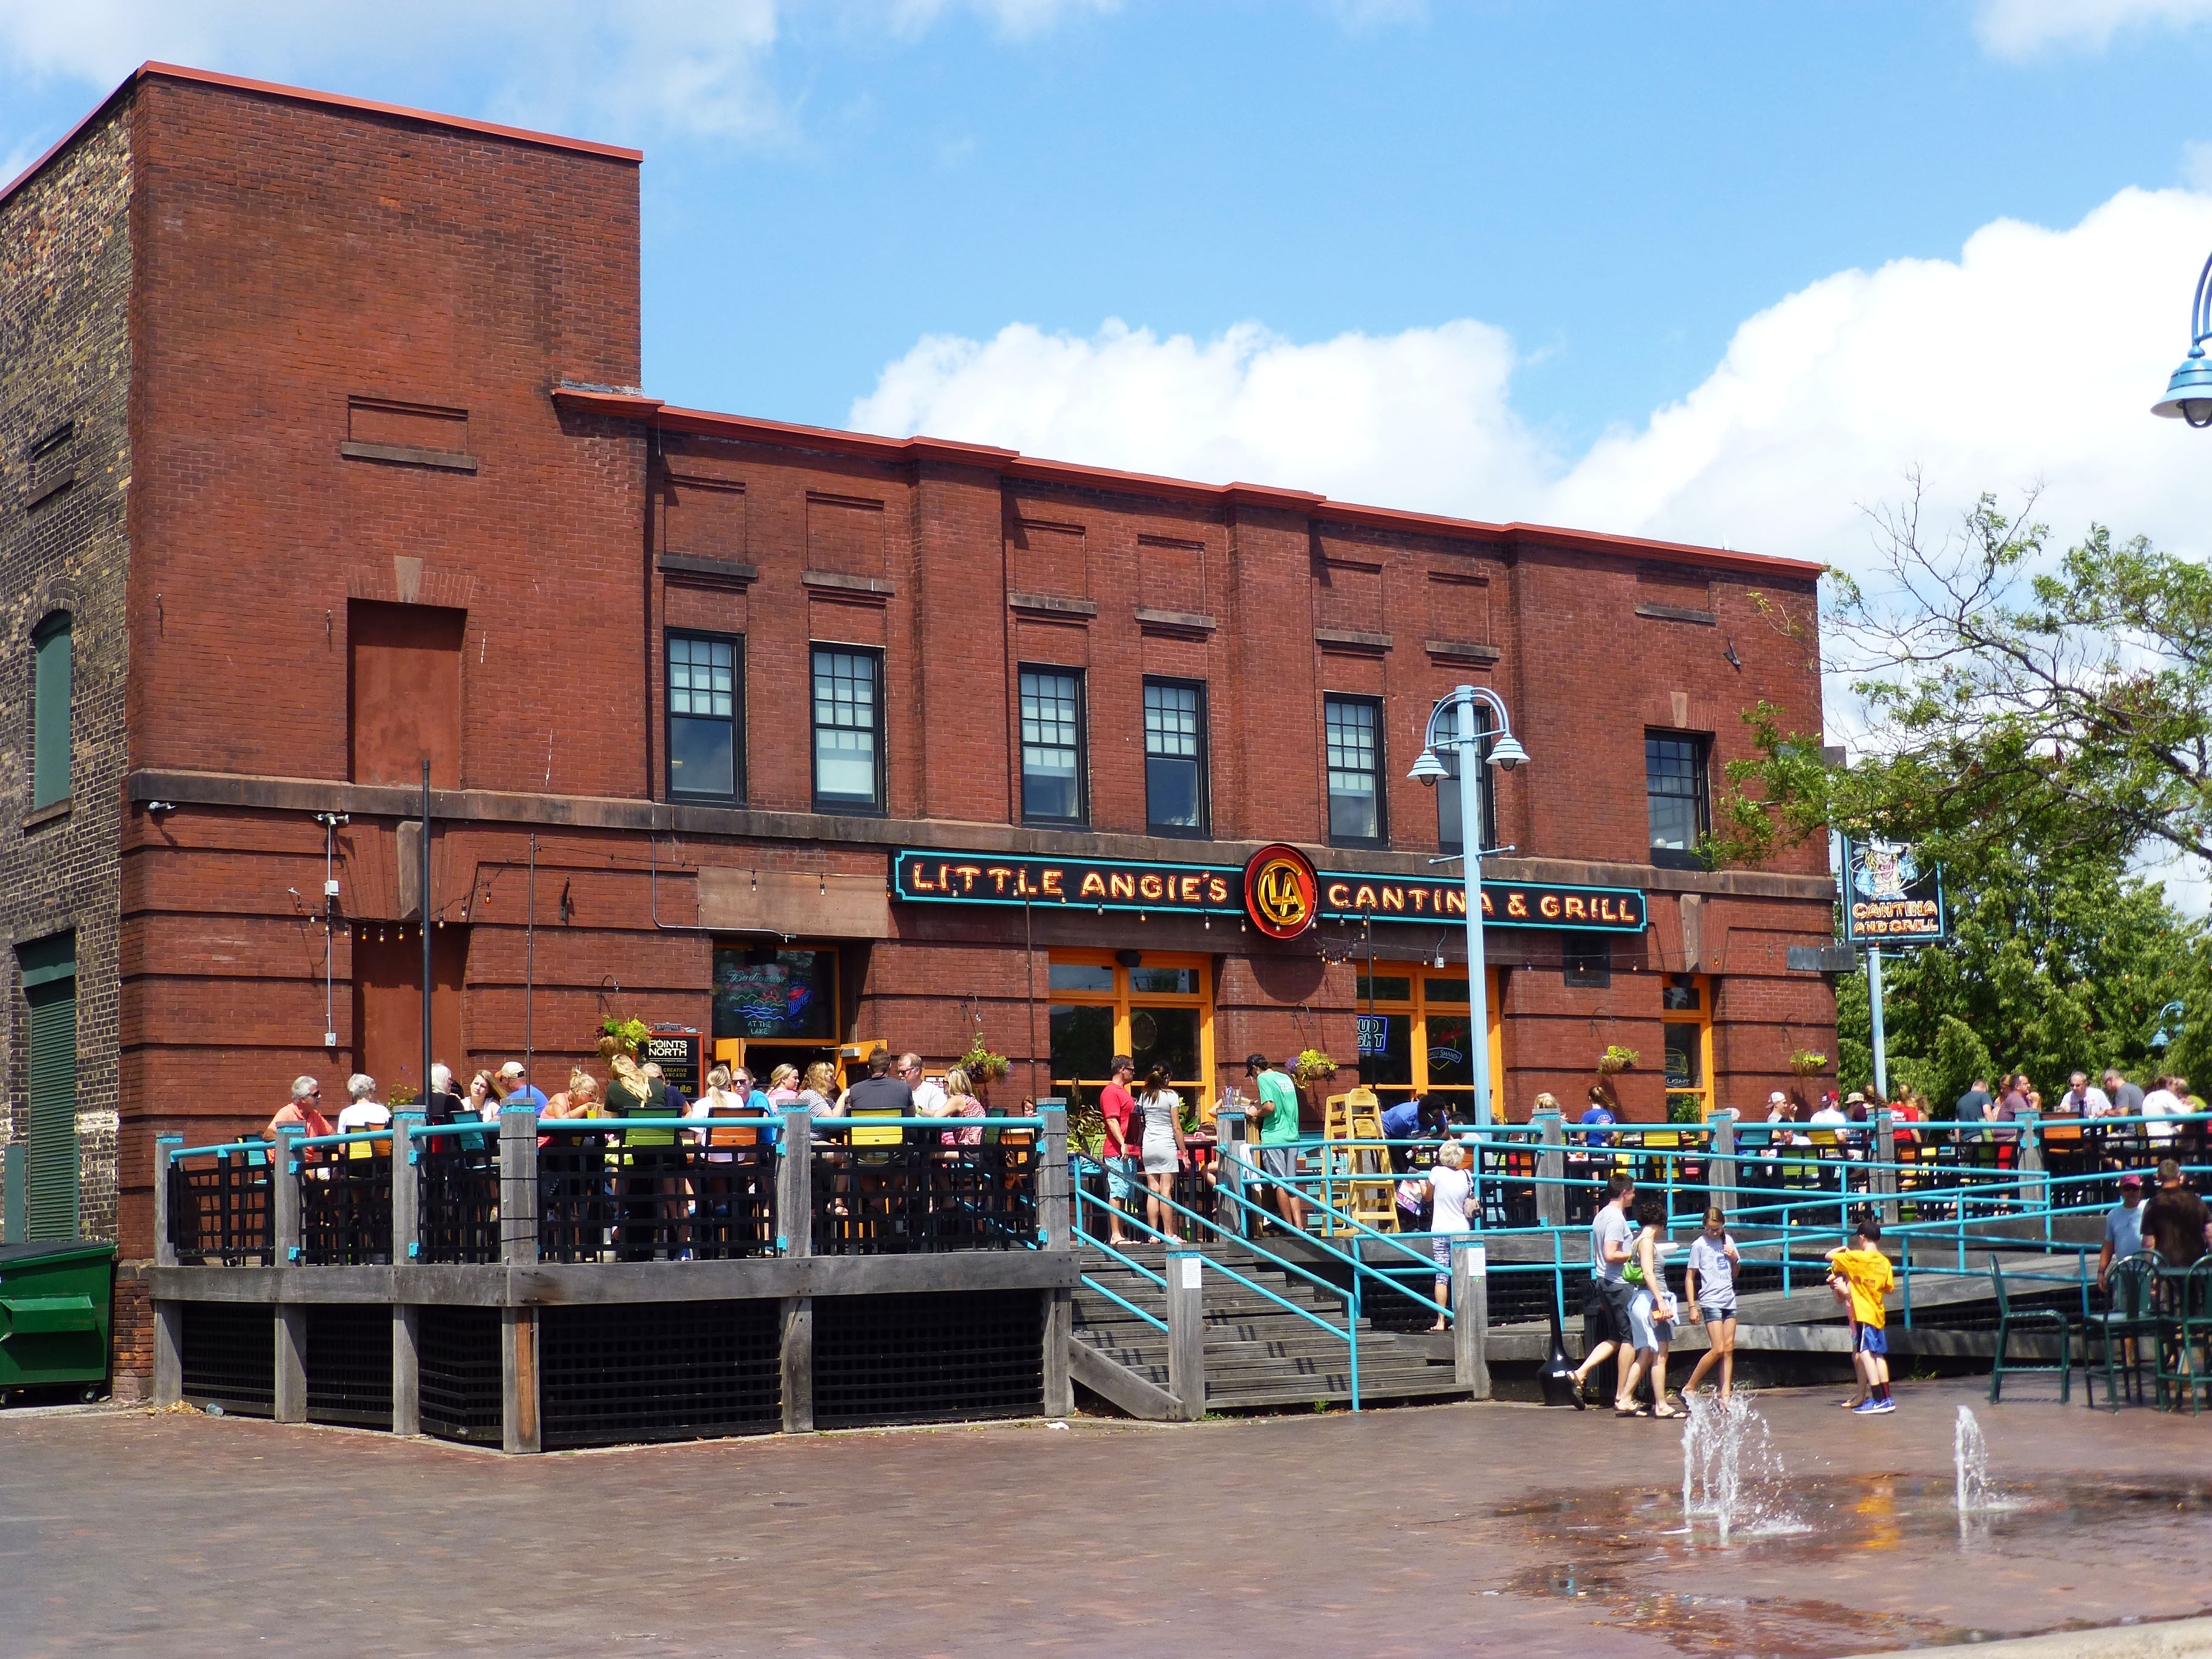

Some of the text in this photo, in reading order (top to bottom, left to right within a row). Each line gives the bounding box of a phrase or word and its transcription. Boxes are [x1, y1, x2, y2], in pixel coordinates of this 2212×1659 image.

[913, 863, 1228, 903] LITTLE ANGIE'S
[1327, 882, 1636, 923] CANTINA & GRILL
[1852, 900, 1938, 919] CANTINA
[1854, 919, 1939, 934] AND GRILL
[1357, 1019, 1379, 1033] UD
[648, 1039, 688, 1048] POINTS
[1358, 1033, 1384, 1048] GHT
[648, 1048, 687, 1056] NORTH
